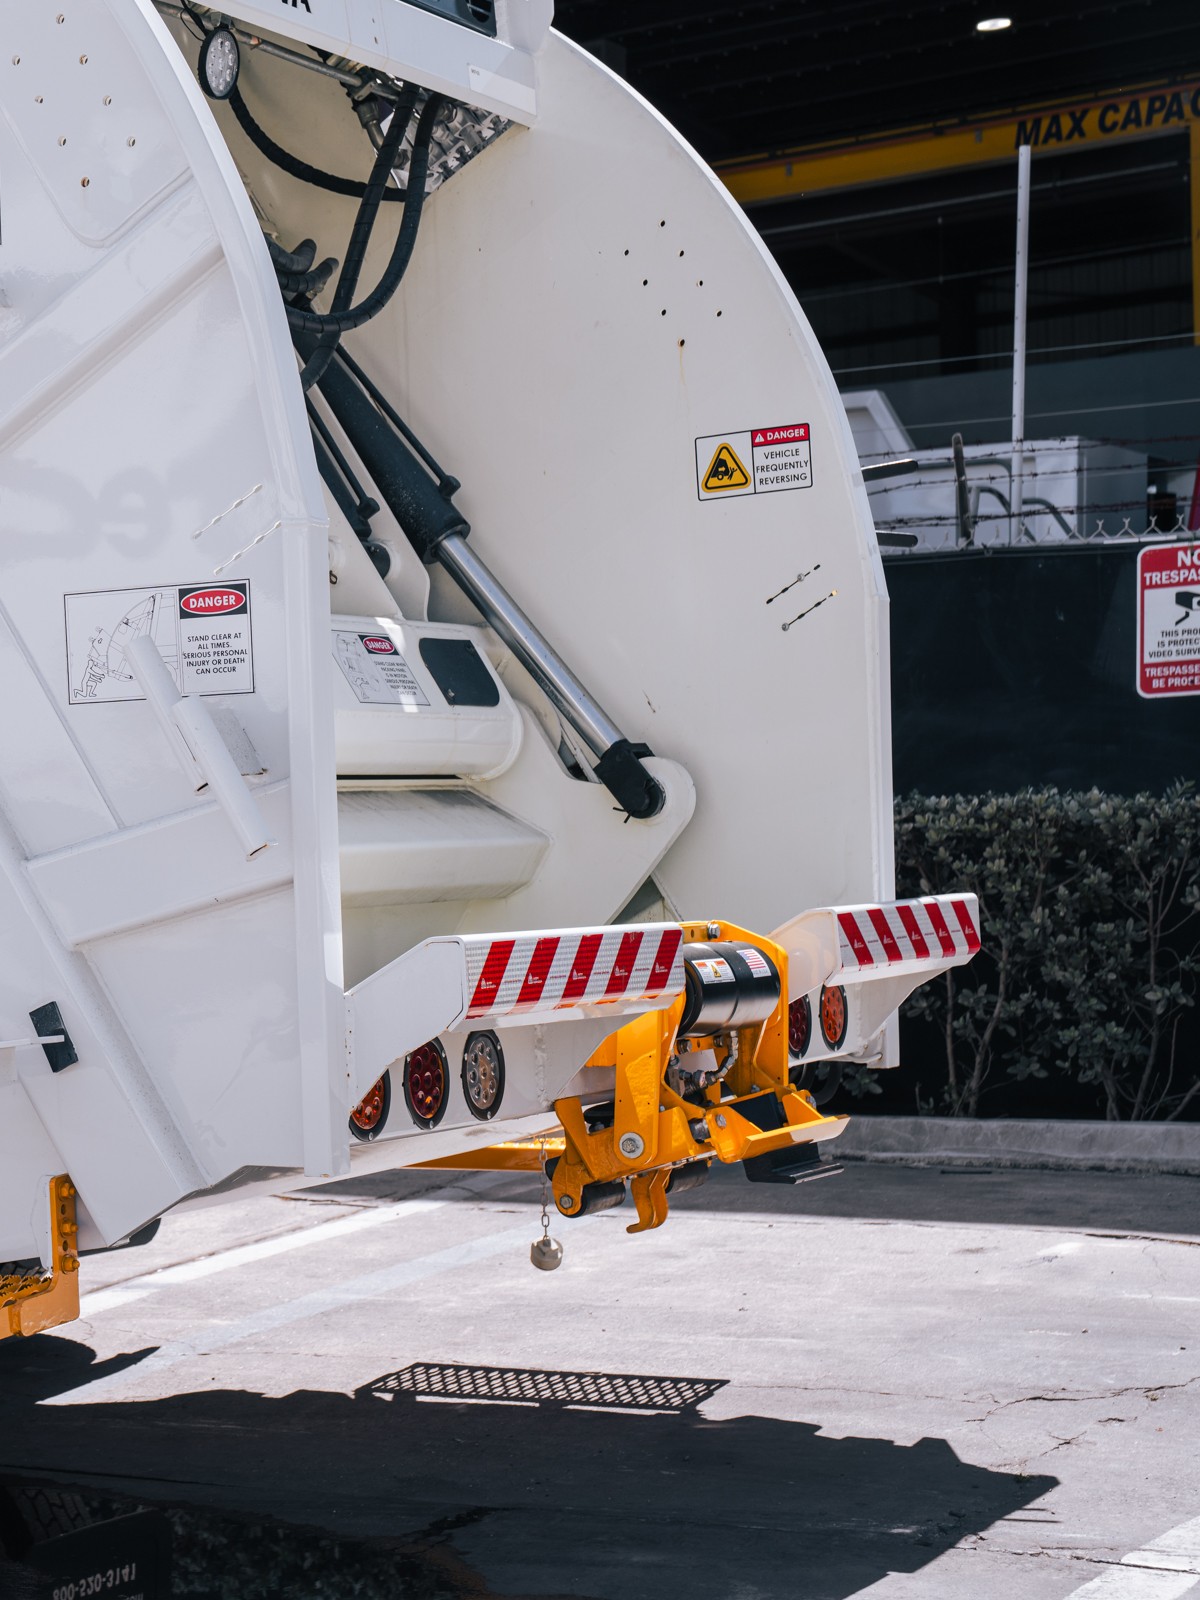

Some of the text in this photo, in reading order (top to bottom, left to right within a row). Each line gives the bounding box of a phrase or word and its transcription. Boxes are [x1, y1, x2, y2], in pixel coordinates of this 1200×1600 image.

[1015, 109, 1090, 150] MAX
[767, 428, 805, 440] DANGER
[763, 449, 799, 460] VEHICLE
[756, 460, 808, 473] FREQUENTLY
[759, 473, 807, 485] REVERSING
[1144, 568, 1200, 586] TRESPA
[190, 595, 236, 608] DANGER
[1182, 628, 1200, 636] PRO
[366, 641, 391, 650] DANGER
[213, 649, 247, 657] PERSONAL
[1149, 650, 1173, 658] VIDEO
[1152, 678, 1165, 688] BE
